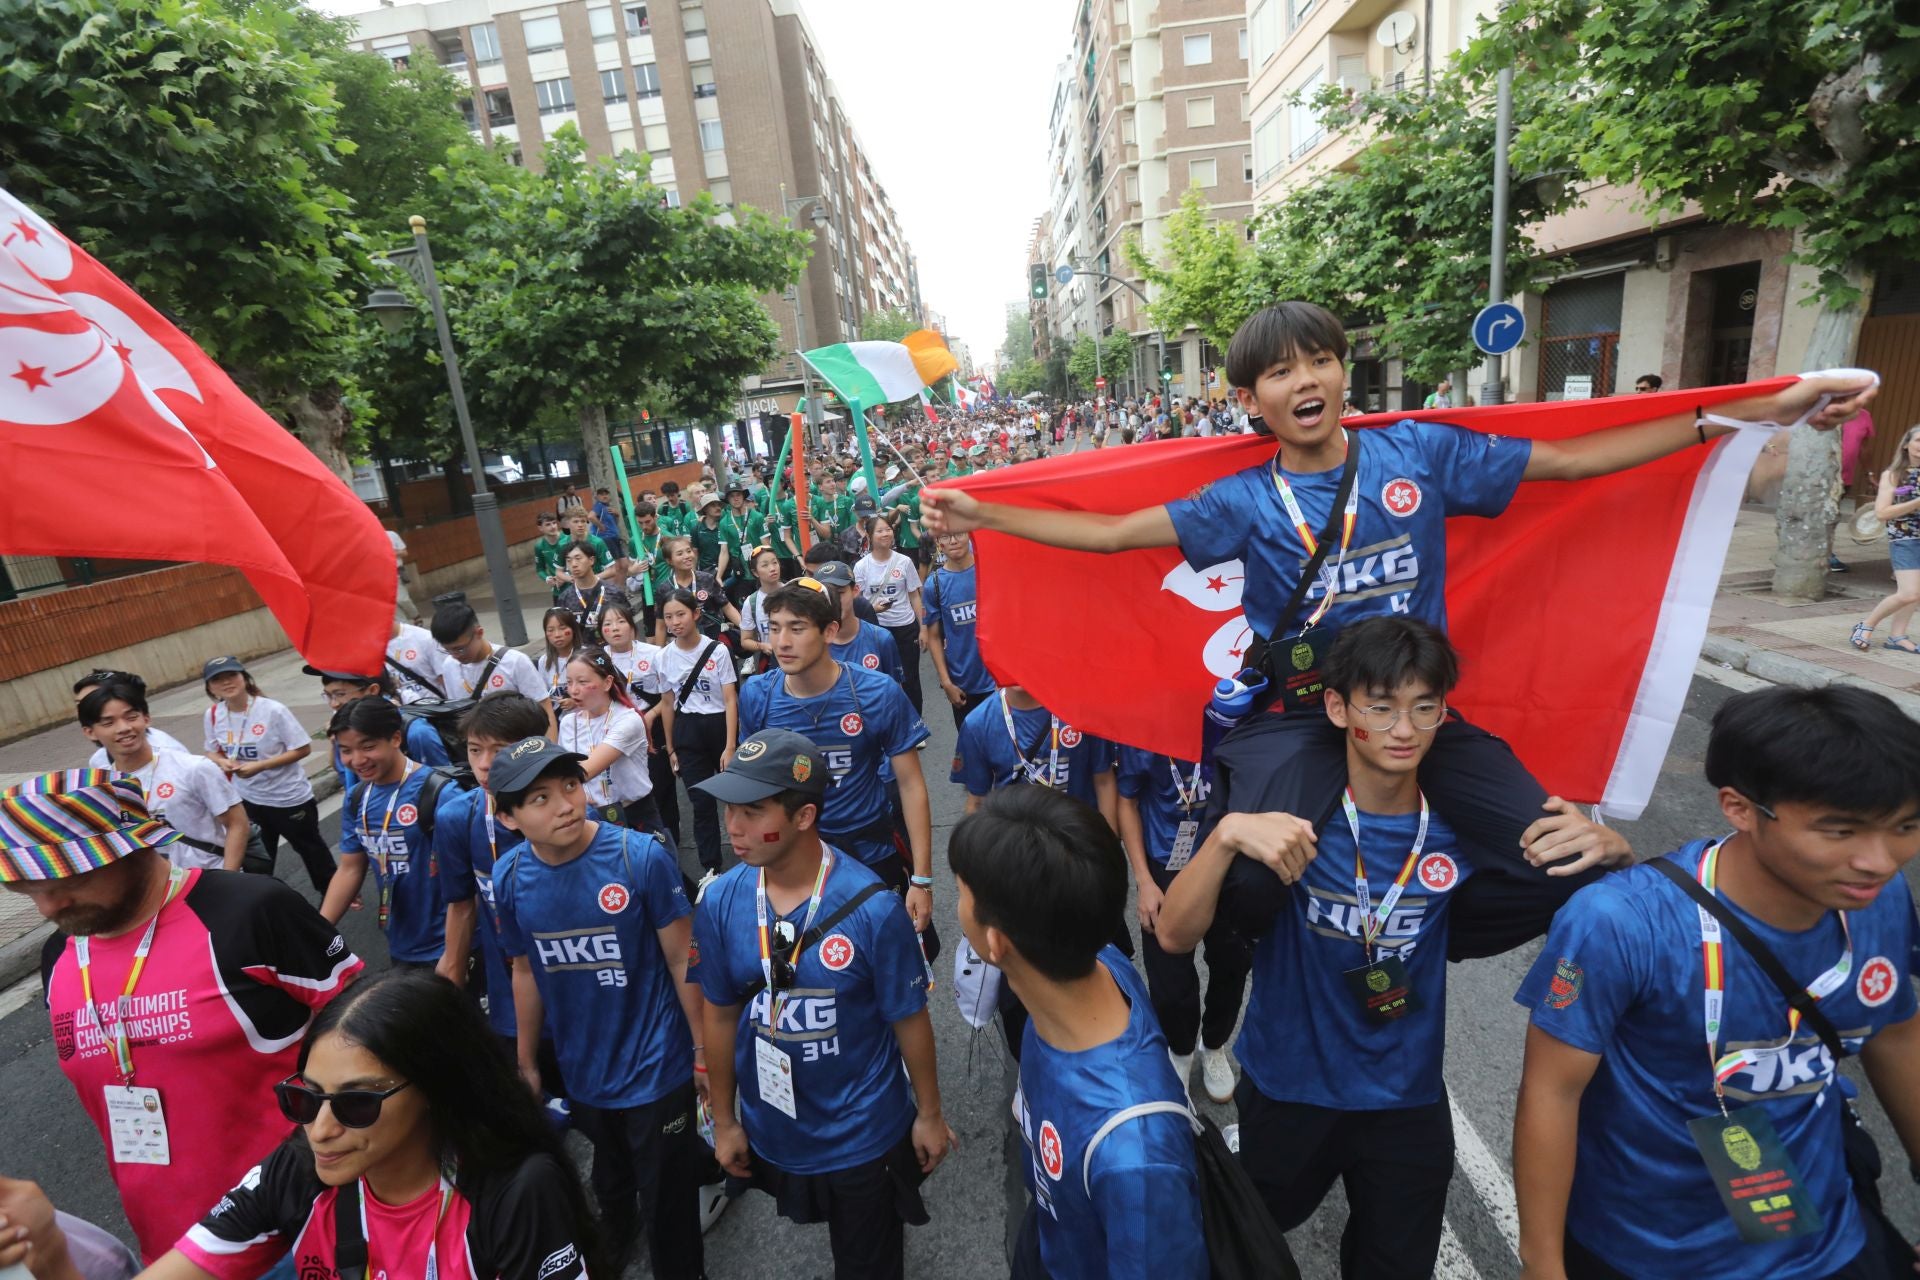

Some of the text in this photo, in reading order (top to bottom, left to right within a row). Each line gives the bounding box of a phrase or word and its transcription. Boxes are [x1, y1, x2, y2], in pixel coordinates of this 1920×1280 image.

[950, 604, 977, 621] HK
[740, 741, 762, 753] KG
[534, 933, 622, 966] HKG
[597, 969, 628, 987] 95
[750, 992, 837, 1031] HKG
[802, 1036, 840, 1061] 34
[540, 1249, 577, 1279] DISCRA
